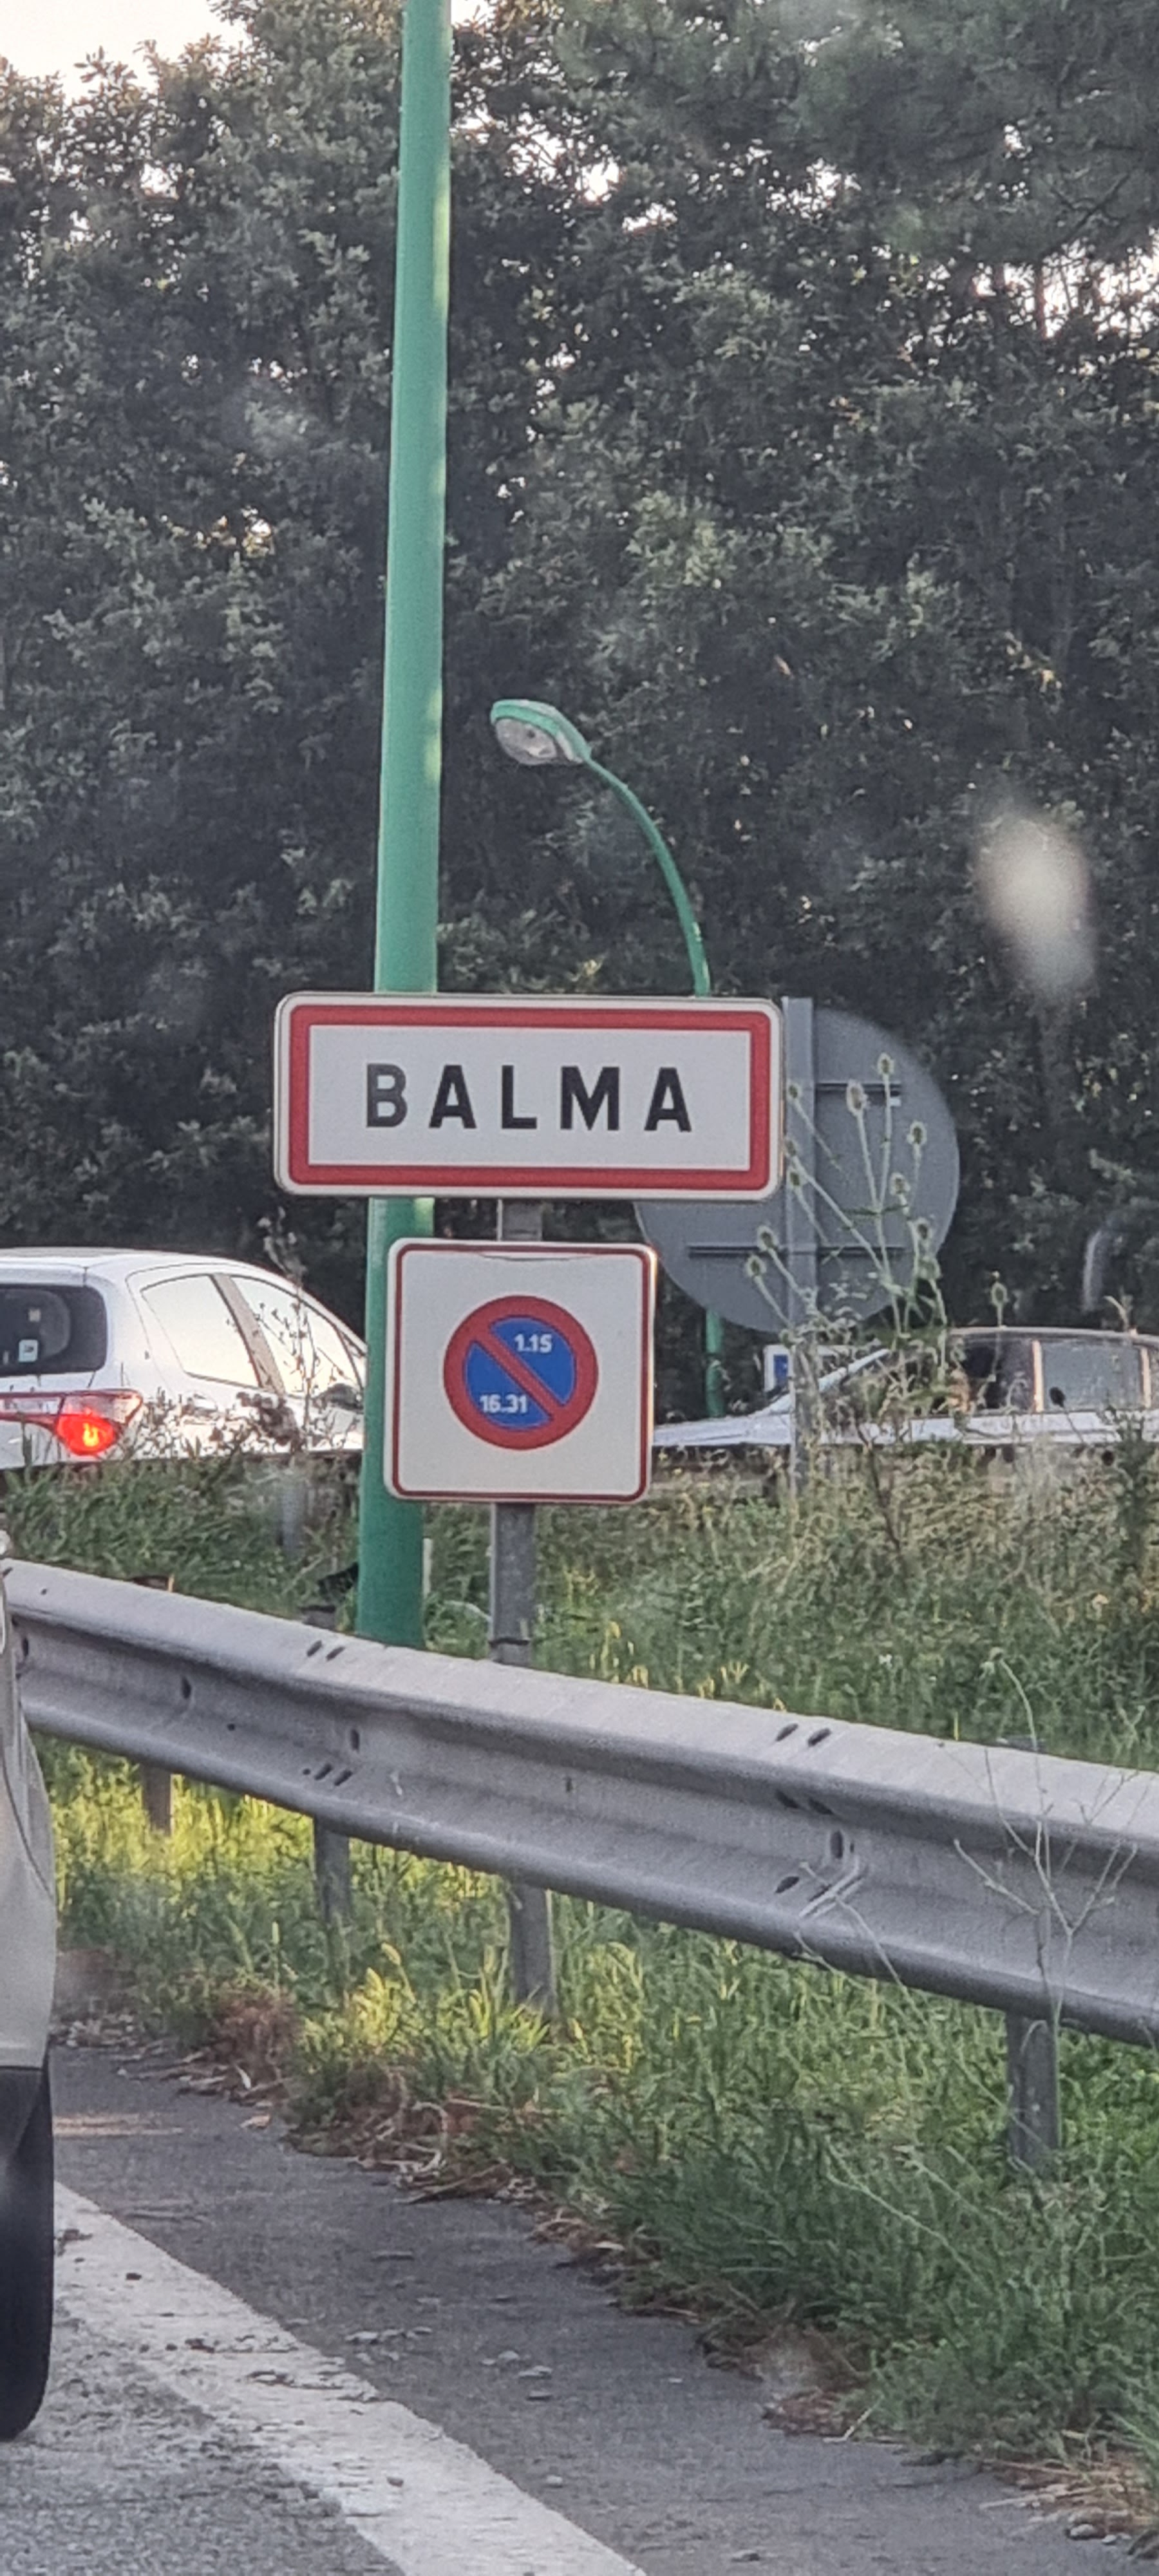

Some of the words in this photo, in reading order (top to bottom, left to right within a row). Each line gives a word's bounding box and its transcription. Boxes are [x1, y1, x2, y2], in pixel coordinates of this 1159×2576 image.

[365, 1063, 692, 1133] BALMA
[514, 1334, 552, 1353] 1.15
[480, 1394, 527, 1414] 16.31
